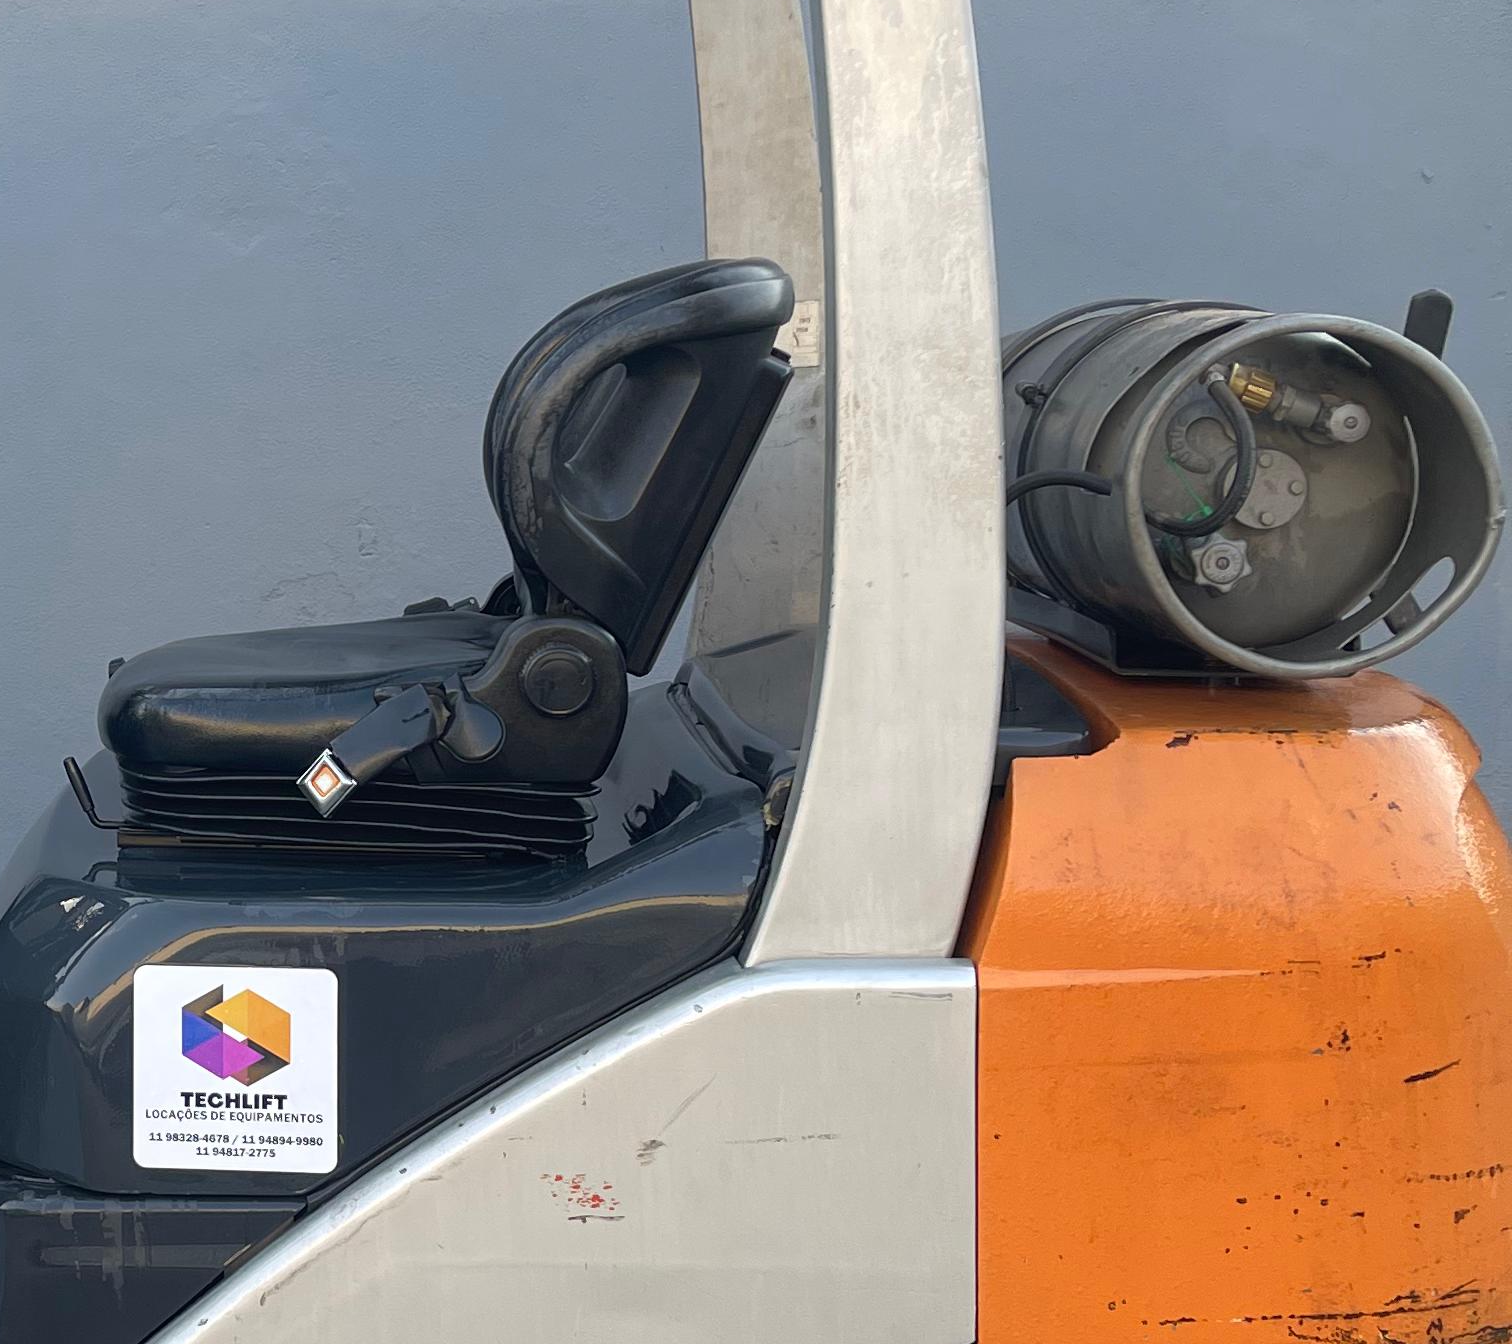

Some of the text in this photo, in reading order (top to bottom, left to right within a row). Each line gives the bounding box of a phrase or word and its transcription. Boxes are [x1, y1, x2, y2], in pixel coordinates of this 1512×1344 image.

[180, 1091, 288, 1110] TECHLIFT
[145, 1108, 324, 1124] LOCAÇÕES DE EQUIPAMENTOS
[149, 1132, 163, 1142] 11
[242, 1135, 256, 1145] 11
[258, 1135, 324, 1146] 94894-9980
[195, 1146, 277, 1158] 11 94817-2775
